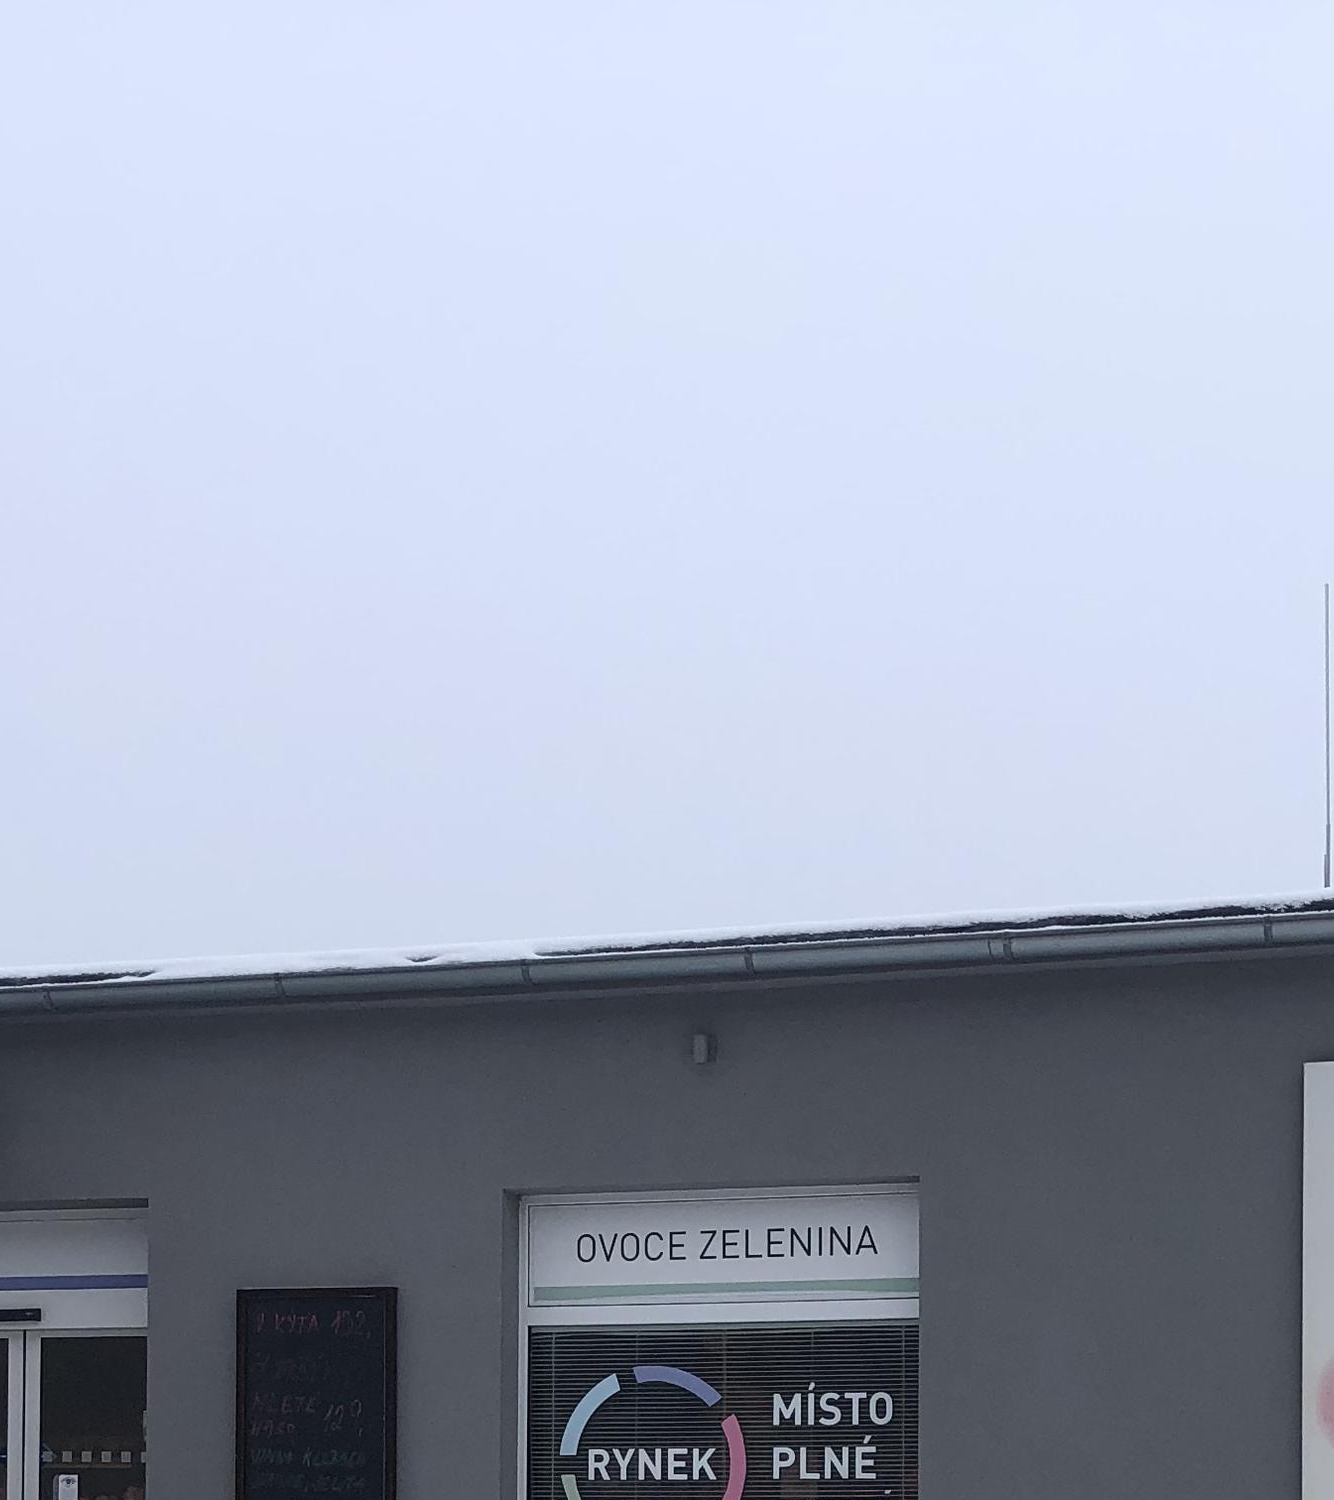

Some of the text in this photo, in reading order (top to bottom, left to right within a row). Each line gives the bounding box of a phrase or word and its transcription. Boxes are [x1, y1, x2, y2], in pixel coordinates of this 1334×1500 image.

[576, 1224, 879, 1263] OVOCE ZELENINA
[772, 1382, 894, 1426] MÍSTO
[587, 1448, 717, 1481] RYNEK
[772, 1435, 878, 1480] PLNÉ
